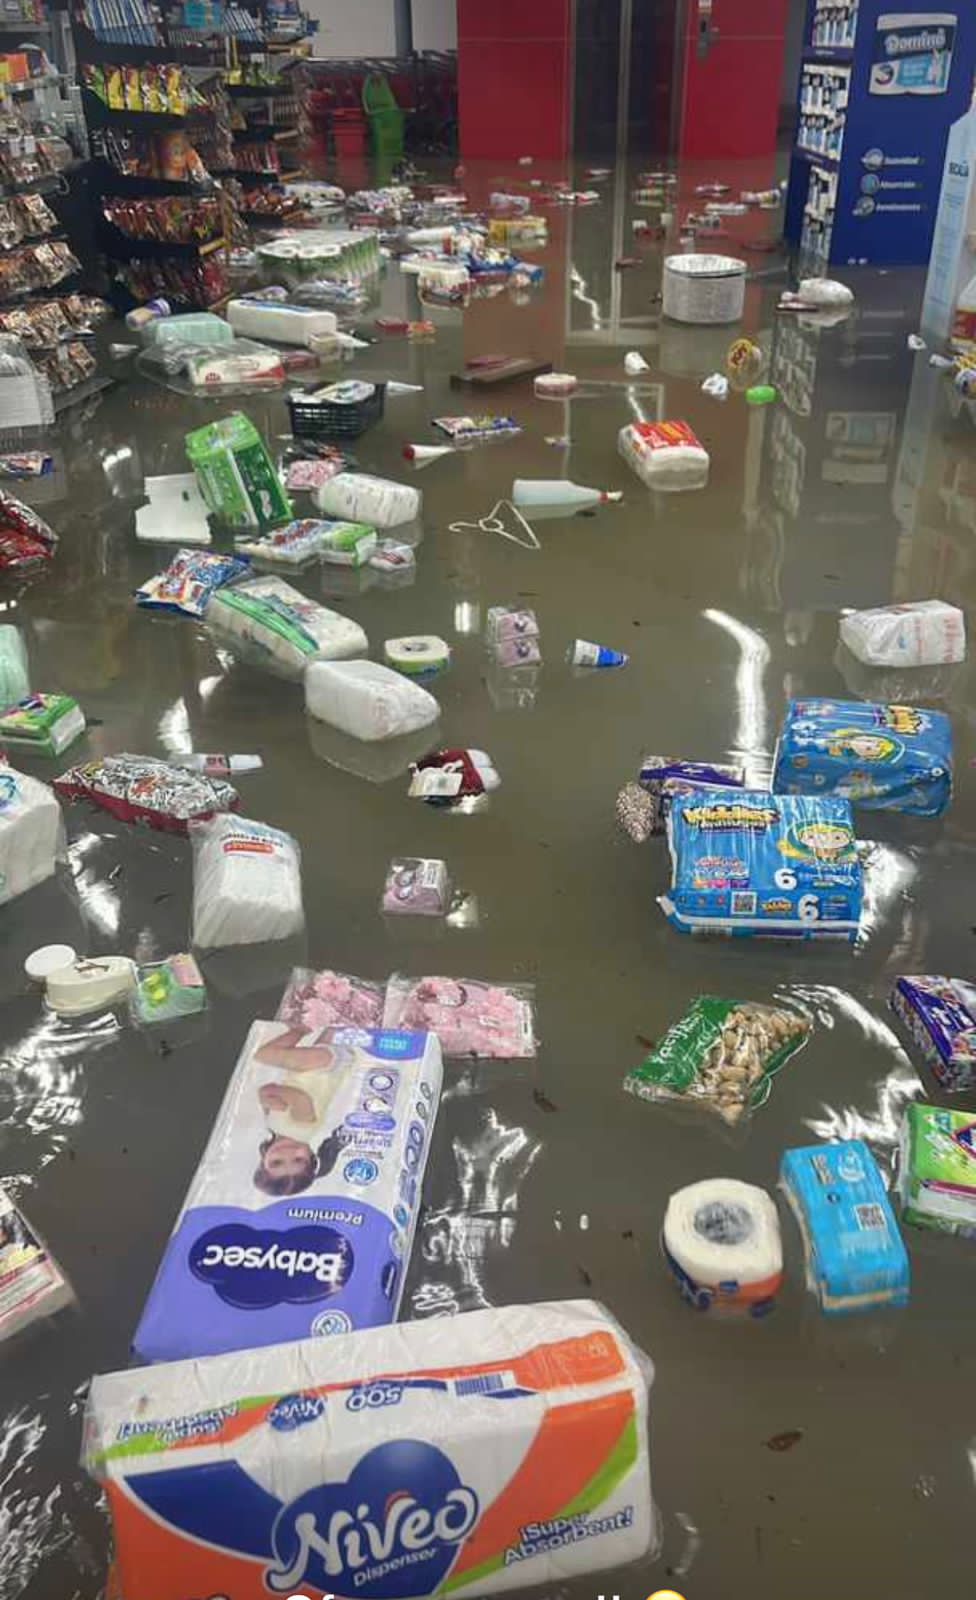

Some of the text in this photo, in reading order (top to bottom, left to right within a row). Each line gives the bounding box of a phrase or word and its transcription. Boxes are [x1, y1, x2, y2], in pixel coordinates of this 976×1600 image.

[774, 868, 797, 890] 6
[798, 894, 819, 920] 6
[202, 1243, 342, 1283] Babysec
[347, 1386, 403, 1411] 500
[268, 1488, 477, 1591] Niveo
[503, 1504, 634, 1567] Absorbent!
[352, 1547, 437, 1587] Dispenser
